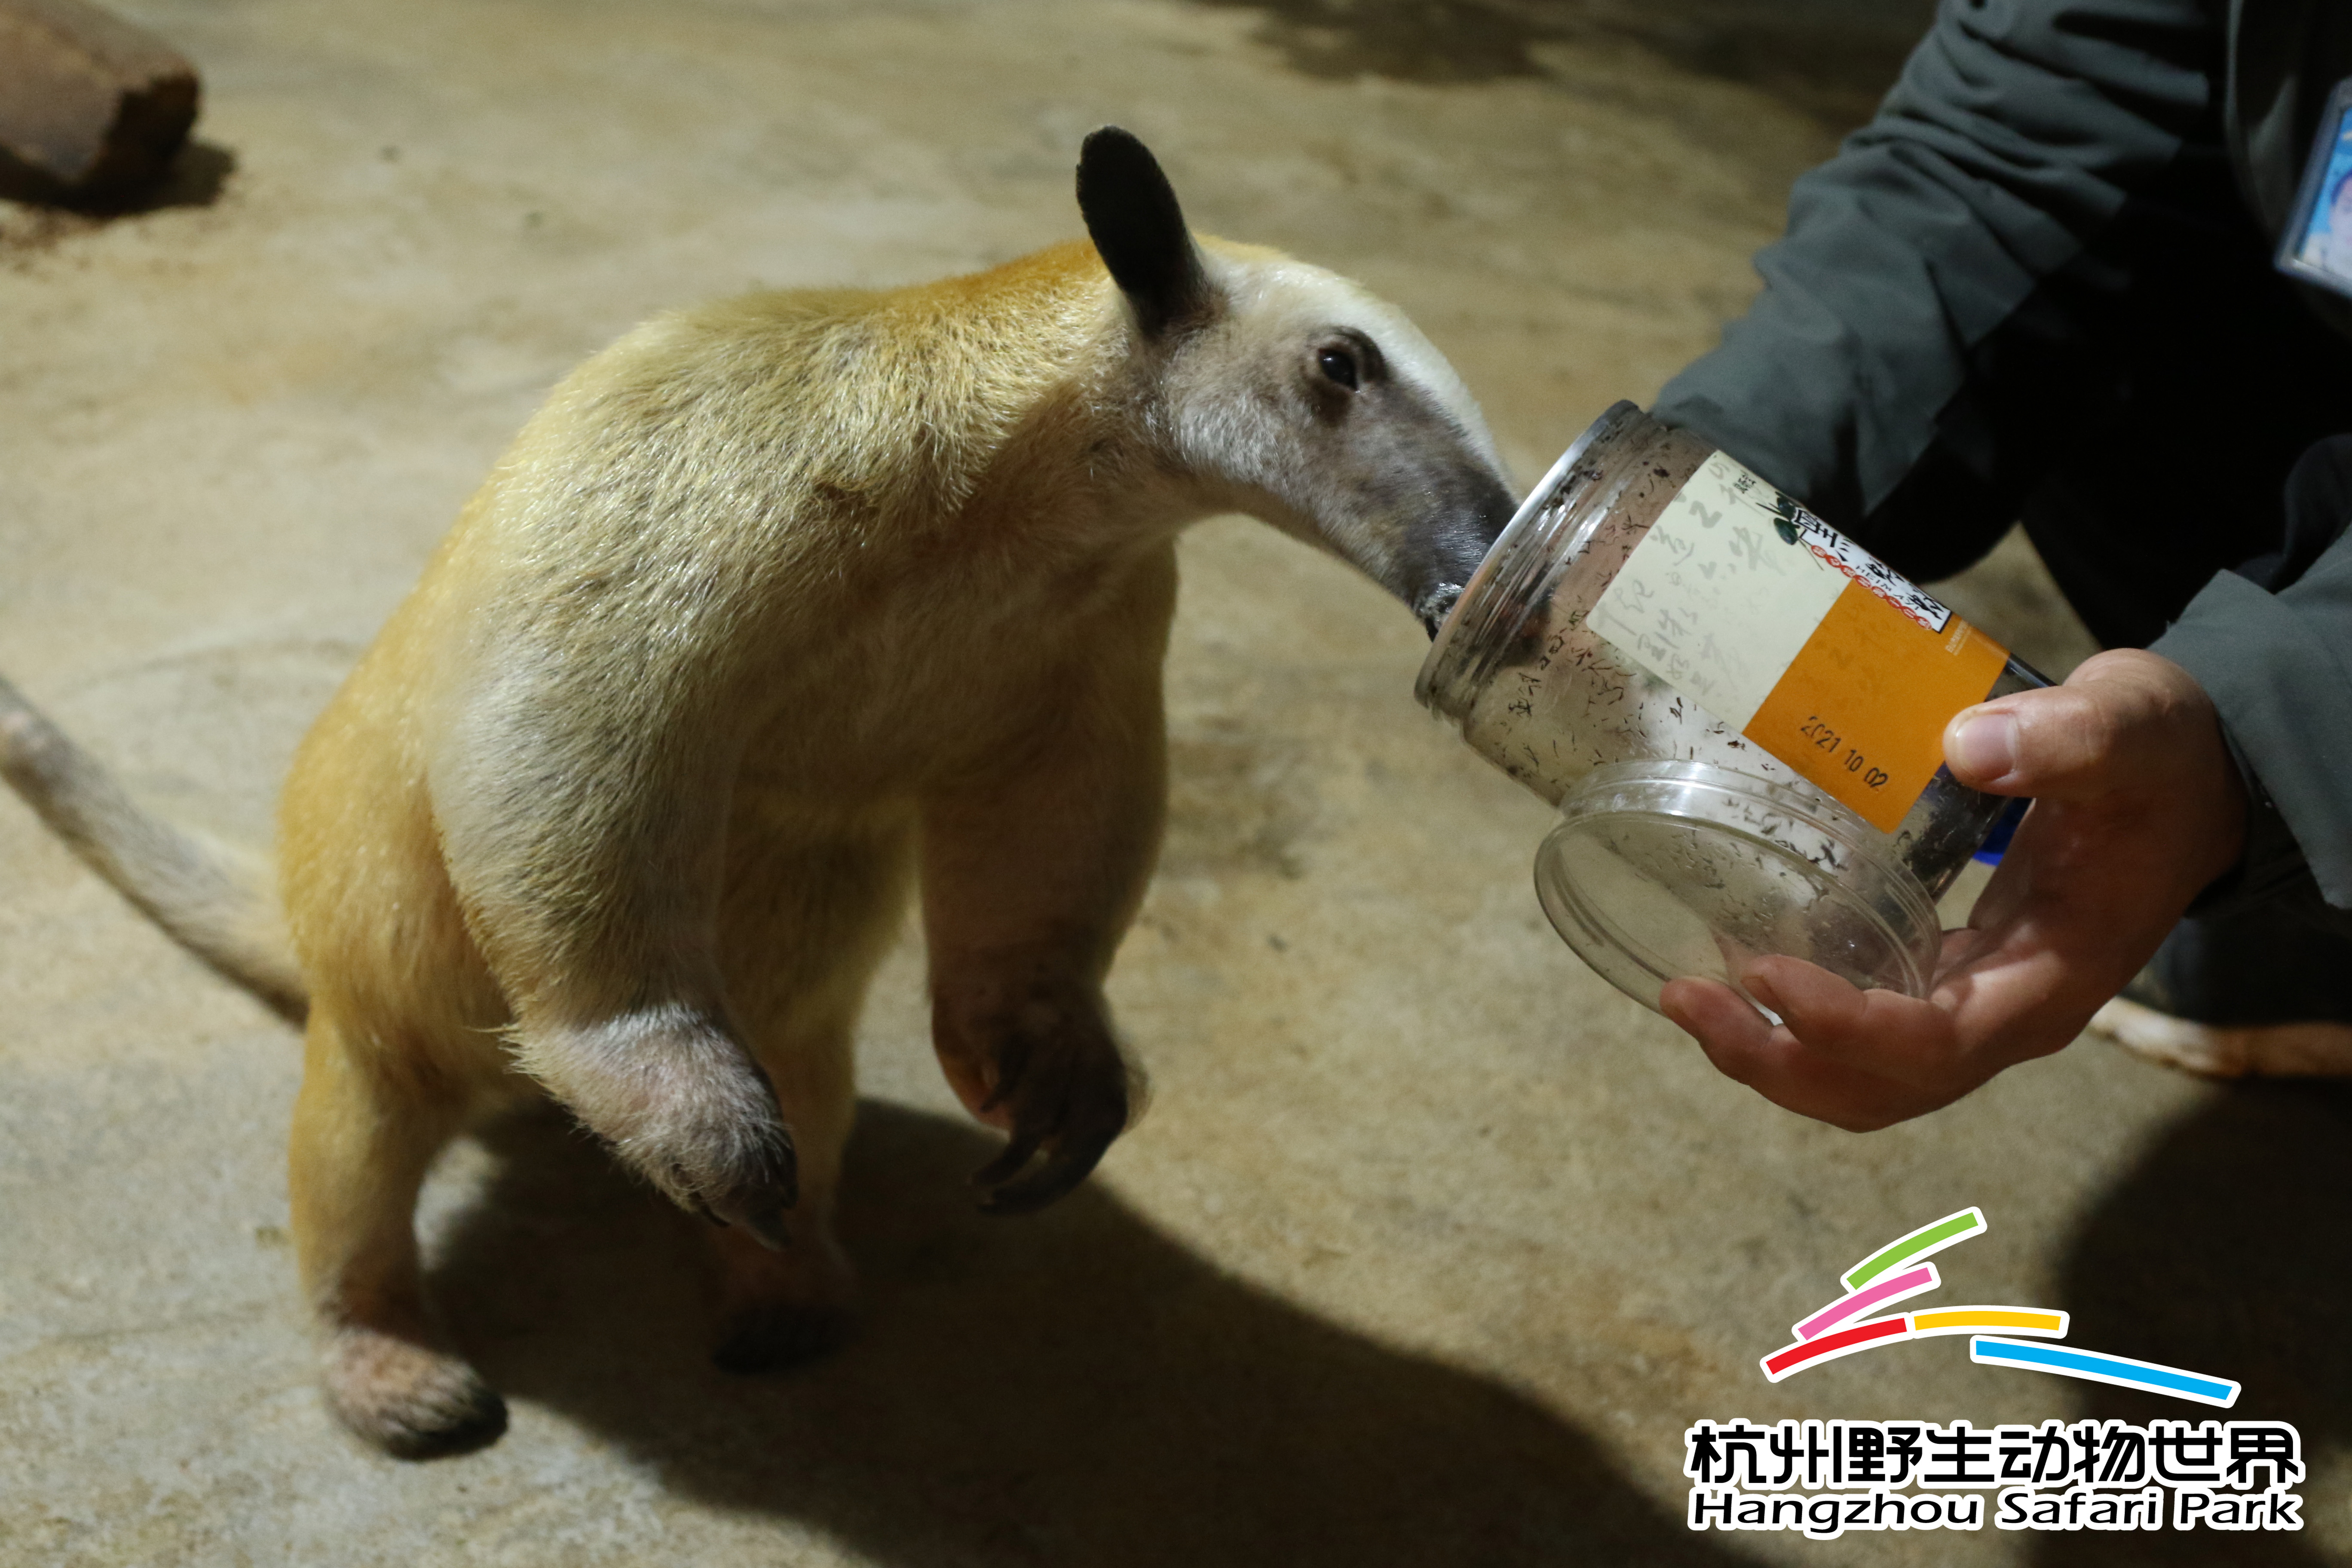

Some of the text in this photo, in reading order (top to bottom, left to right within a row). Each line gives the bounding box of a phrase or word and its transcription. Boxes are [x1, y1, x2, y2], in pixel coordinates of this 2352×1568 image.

[1855, 565, 1920, 610] HEIMAYI
[1801, 716, 1888, 791] 2021 10 02
